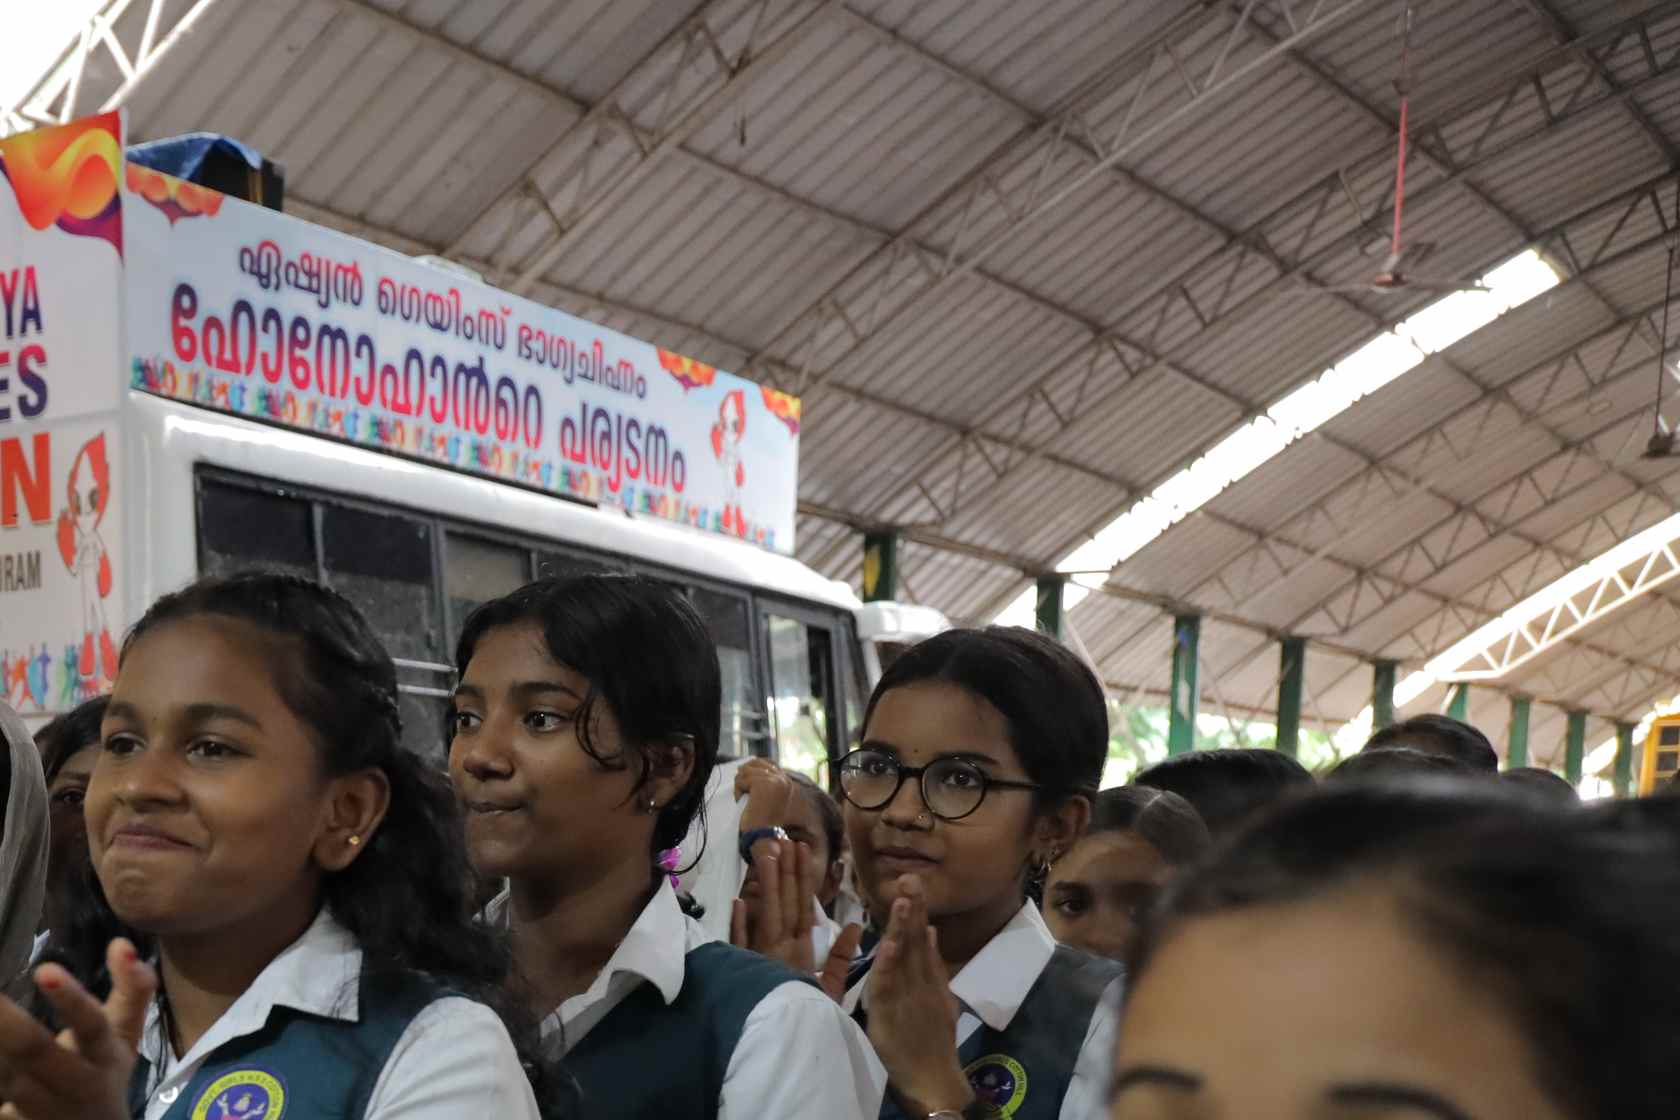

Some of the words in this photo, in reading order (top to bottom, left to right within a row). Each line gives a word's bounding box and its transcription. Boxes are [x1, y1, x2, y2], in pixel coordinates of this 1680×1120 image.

[239, 239, 364, 310] ഏഷ്യൻ
[377, 276, 513, 351] ഗെയിംസ്
[559, 401, 686, 494] പര്യടനം
